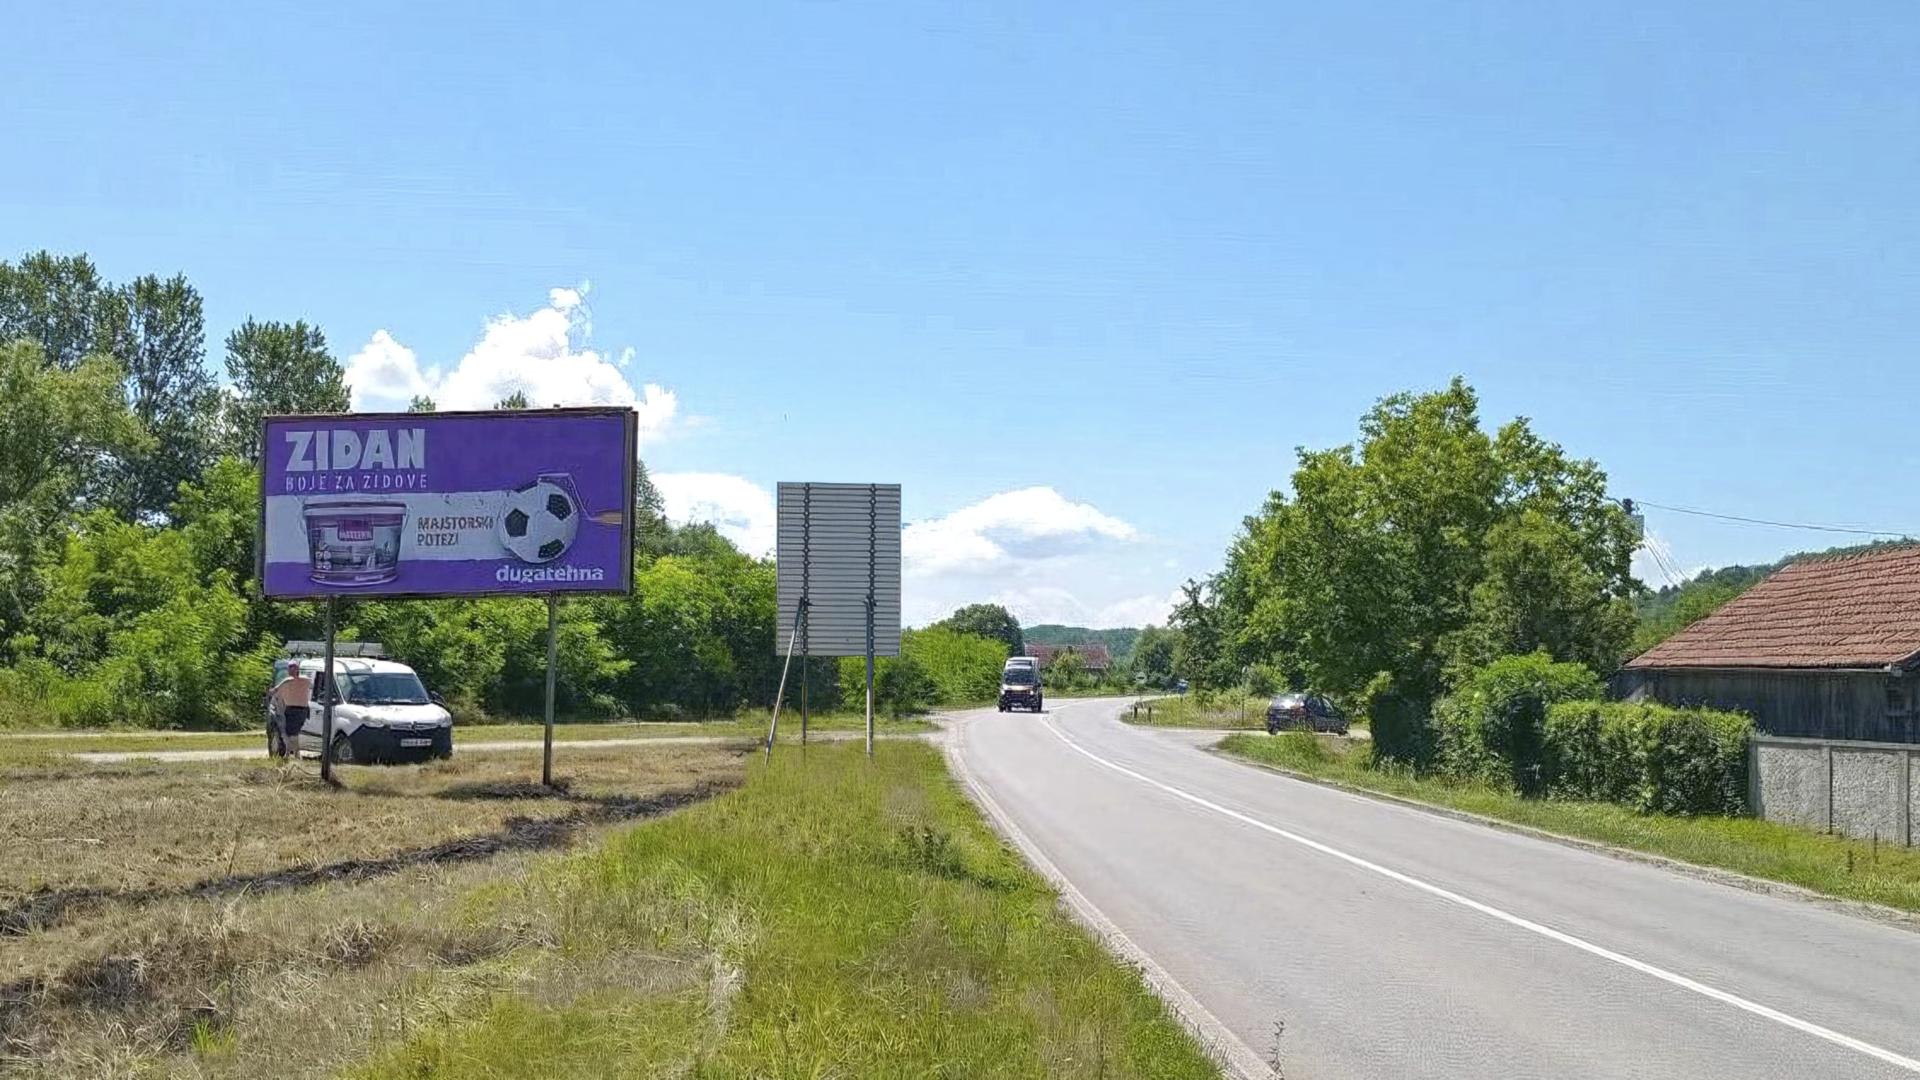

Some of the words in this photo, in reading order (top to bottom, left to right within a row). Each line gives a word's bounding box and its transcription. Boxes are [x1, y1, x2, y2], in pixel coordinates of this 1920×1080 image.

[286, 428, 425, 472] ZIDAN
[286, 475, 327, 492] BOJE
[335, 475, 355, 490] ZA
[363, 473, 427, 489] ZIDOVE
[417, 532, 459, 546] POTEZI
[496, 565, 604, 583] dugatehna
